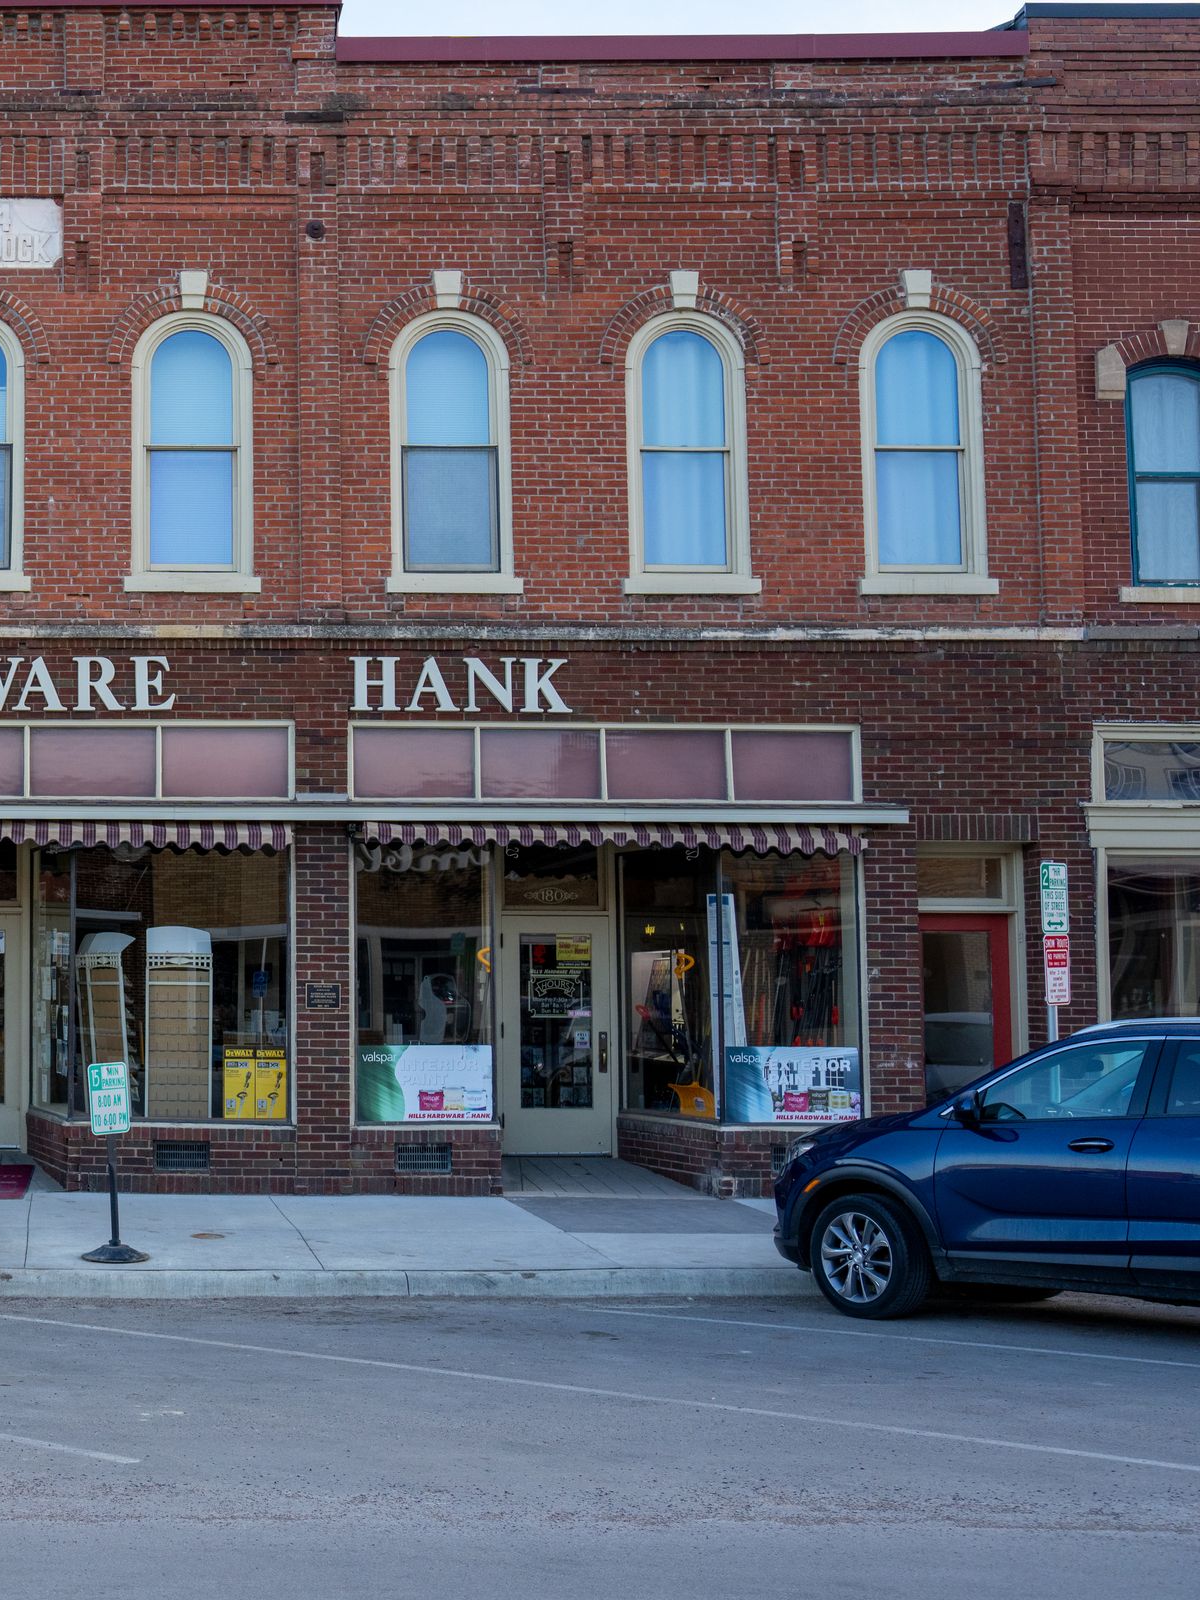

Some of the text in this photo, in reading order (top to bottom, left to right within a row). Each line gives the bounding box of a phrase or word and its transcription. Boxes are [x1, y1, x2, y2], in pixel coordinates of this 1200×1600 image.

[349, 655, 573, 713] HANK
[1042, 868, 1049, 886] 2
[540, 890, 564, 902] 180
[1044, 891, 1065, 900] THIS SIDE
[1051, 901, 1065, 911] STREET
[541, 980, 570, 990] HOURS
[362, 1051, 396, 1064] valspar
[729, 1052, 760, 1065] valspa
[106, 1067, 118, 1076] MIN
[400, 1059, 478, 1072] INTERIOR
[768, 1059, 851, 1072] EXTERIOR
[91, 1069, 100, 1087] 15
[102, 1078, 125, 1087] PARKING
[401, 1073, 448, 1086] PAINT
[768, 1073, 816, 1086] PAINT
[113, 1094, 122, 1106] AM
[94, 1114, 102, 1127] TO
[119, 1112, 127, 1125] PM
